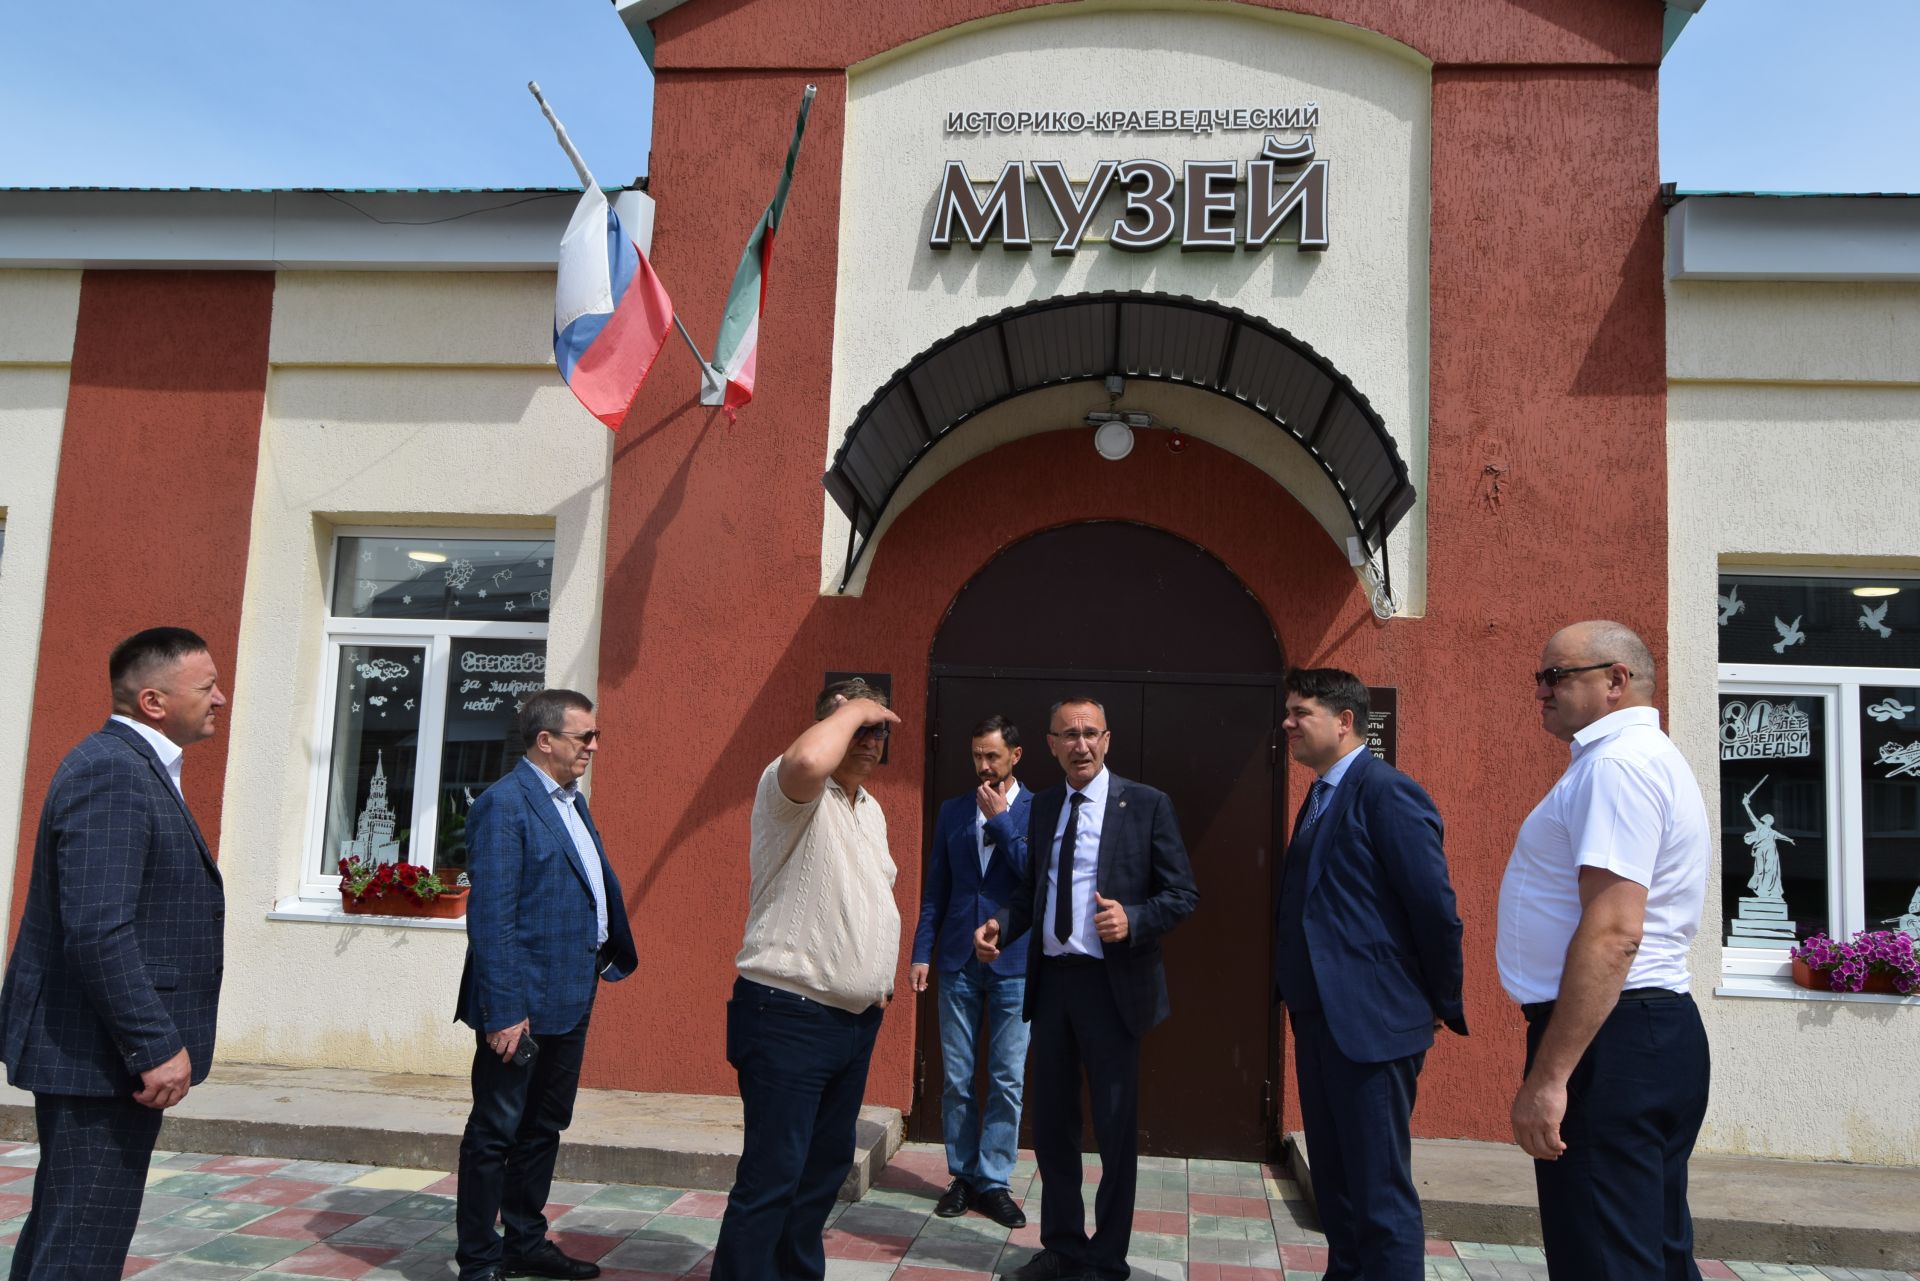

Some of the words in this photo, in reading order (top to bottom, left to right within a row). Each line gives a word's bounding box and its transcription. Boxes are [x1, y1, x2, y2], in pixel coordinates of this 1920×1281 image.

[946, 102, 1320, 133] ИСТОРИКО-КРАЕВЕДЧЕСКИЙ
[929, 134, 1330, 257] МУЗЕЙ
[460, 679, 481, 693] за
[488, 680, 545, 697] мирно
[1720, 700, 1774, 744] 80
[1723, 742, 1808, 758] ПОБЕДЫ!
